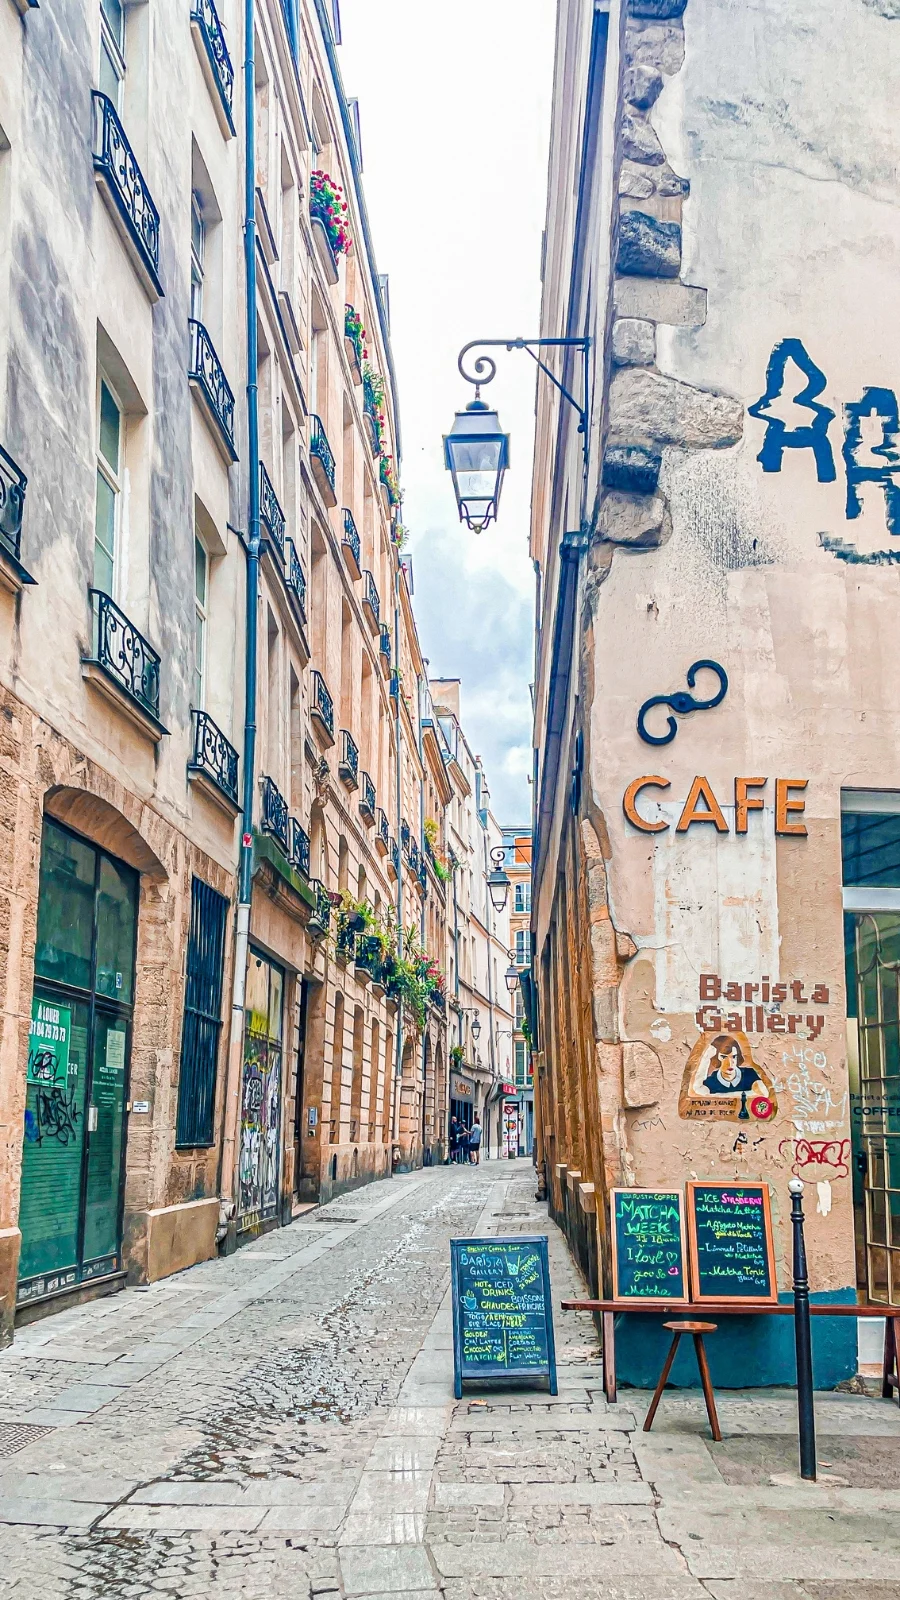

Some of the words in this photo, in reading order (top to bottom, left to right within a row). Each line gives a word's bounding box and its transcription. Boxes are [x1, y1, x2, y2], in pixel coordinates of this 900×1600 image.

[622, 775, 810, 836] CAFE
[699, 974, 830, 1004] Barista
[44, 1005, 60, 1025] LOUER
[695, 1005, 825, 1041] Gallery
[52, 1026, 59, 1041] 73
[59, 1028, 66, 1042] 73
[704, 1194, 720, 1203] ICE
[616, 1200, 680, 1222] MATCHA
[696, 1204, 733, 1213] Matcha
[626, 1222, 670, 1233] WEEK
[627, 1248, 634, 1260] I
[460, 1253, 504, 1267] BARISTA
[470, 1267, 504, 1276] GALLERY
[709, 1266, 743, 1275] Matcha
[625, 1285, 671, 1296] Matcha
[511, 1295, 544, 1303] BOISSONS
[464, 1345, 492, 1353] CHOCOLAT
